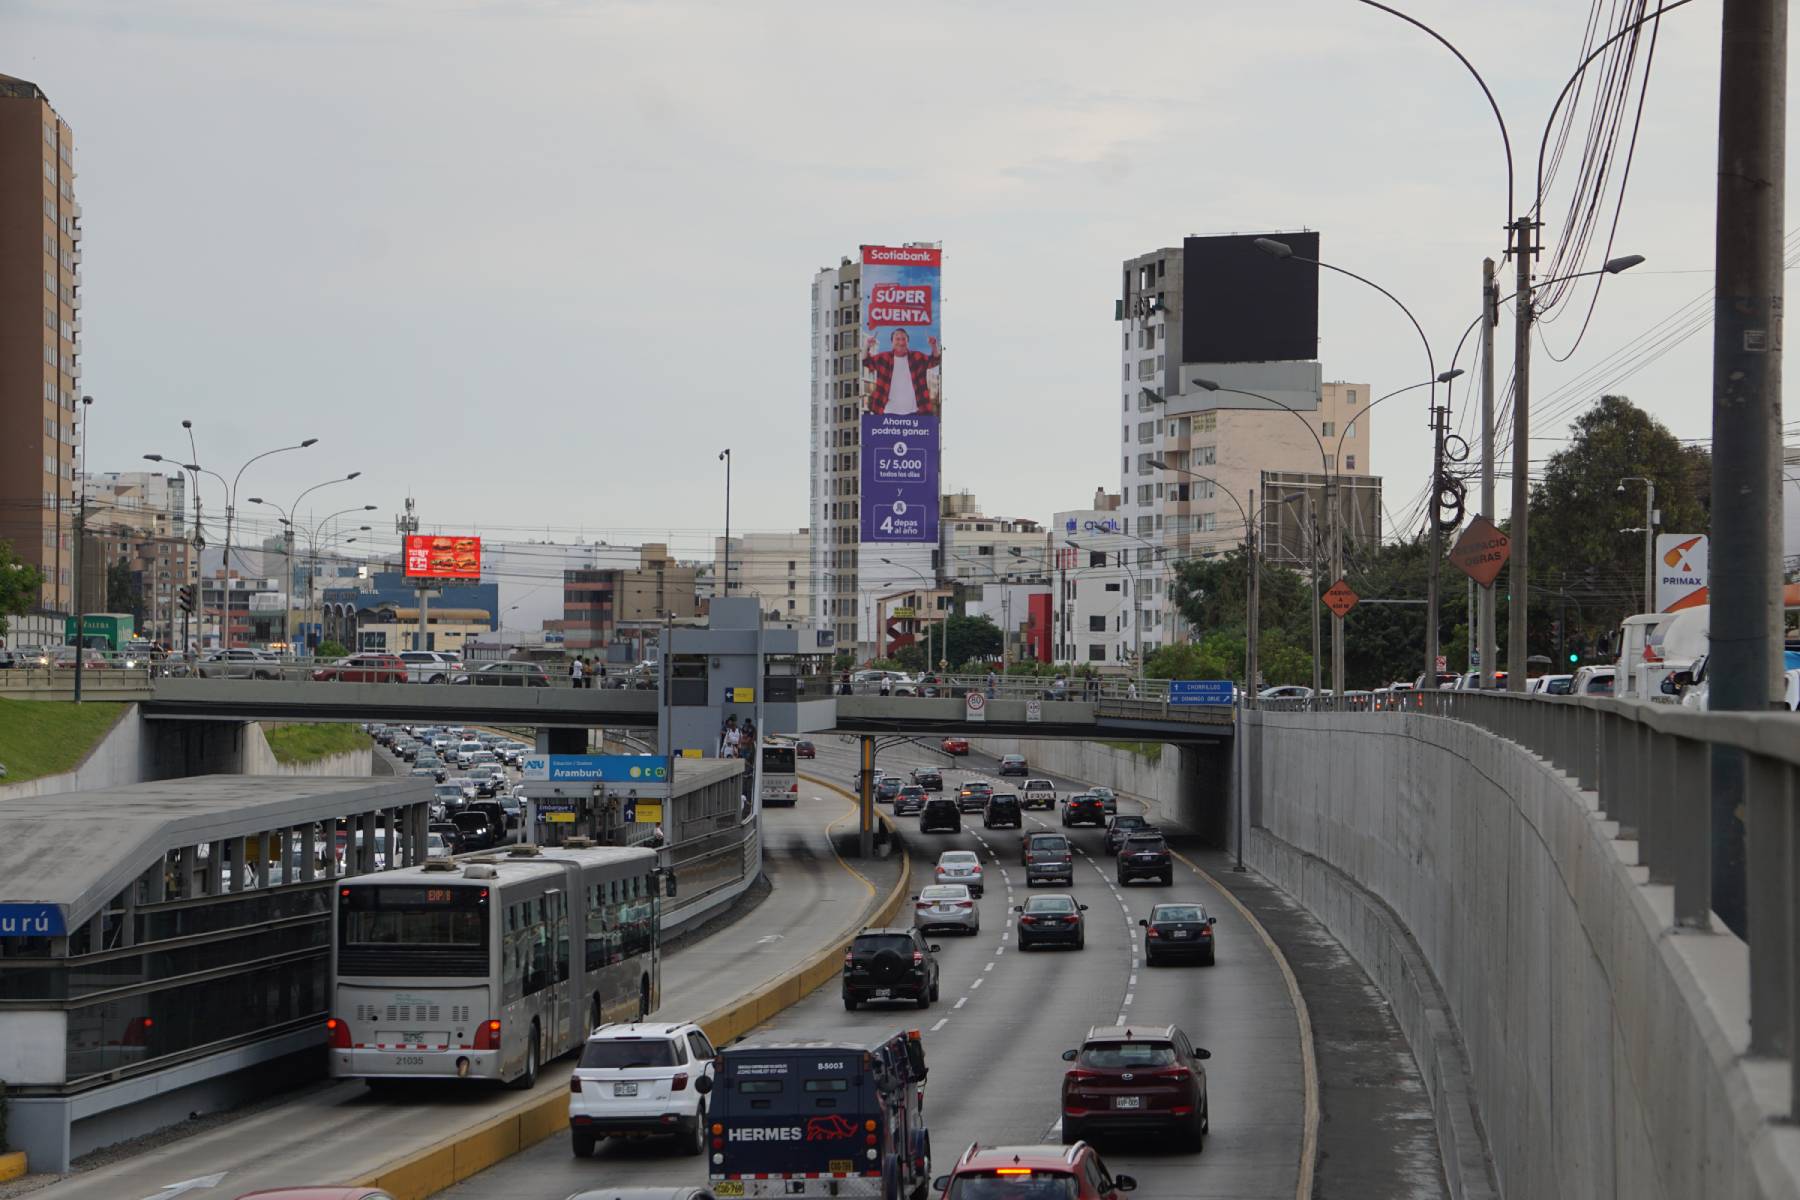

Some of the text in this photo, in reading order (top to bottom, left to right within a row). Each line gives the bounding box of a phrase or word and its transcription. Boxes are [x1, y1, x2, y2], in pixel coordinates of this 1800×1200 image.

[871, 250, 930, 261] Scotiabank
[876, 287, 926, 304] SÚPER
[871, 307, 930, 323] CUENTA
[883, 418, 911, 426] Ahorra
[872, 427, 901, 436] podrás
[879, 459, 891, 469] S/
[897, 488, 903, 497] y
[880, 516, 893, 534] 4
[894, 518, 918, 527] depas
[894, 526, 918, 535] al año
[1663, 577, 1702, 585] PRIMAX
[554, 769, 603, 777] Aramburú
[395, 1057, 424, 1066] 21035
[728, 1126, 802, 1142] HERMES
